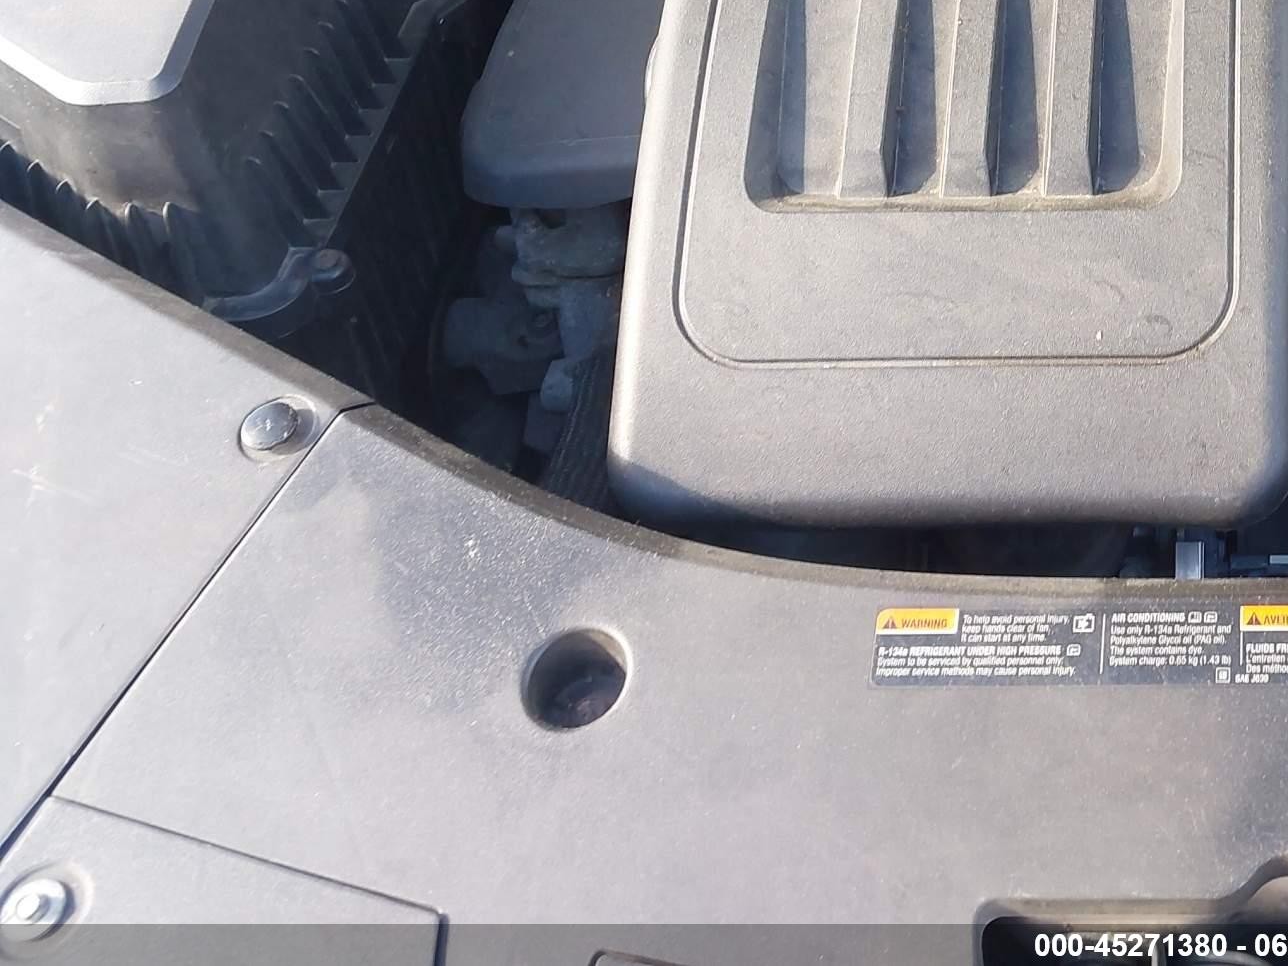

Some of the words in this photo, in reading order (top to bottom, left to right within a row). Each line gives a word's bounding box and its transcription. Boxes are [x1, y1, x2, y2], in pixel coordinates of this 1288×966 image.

[963, 614, 972, 624] To
[973, 614, 990, 624] help
[991, 614, 1012, 624] avoid
[1013, 614, 1045, 624] personal
[1111, 612, 1126, 623] AIR
[1127, 612, 1185, 623] CONDITIONING
[901, 618, 948, 629] WARNING
[962, 624, 980, 634] keep
[982, 624, 1005, 634] hands
[1007, 624, 1026, 634] clear
[1027, 624, 1036, 634] of
[1111, 625, 1126, 635] Use
[1126, 625, 1143, 635] only
[1144, 625, 1172, 635] R-134a
[1174, 625, 1216, 635] Refrigerant
[1217, 625, 1232, 635] and
[967, 634, 982, 643] can
[983, 634, 1001, 643] start
[1003, 634, 1011, 643] at
[1012, 634, 1026, 643] any
[1110, 635, 1157, 645] Polyalkylene
[1158, 635, 1181, 645] Glycol
[1182, 635, 1192, 645] oil
[1194, 635, 1212, 645] (PAG
[878, 645, 909, 656] R-134a
[909, 645, 966, 656] REFRIGERANT
[967, 645, 995, 656] UNDER
[996, 645, 1017, 656] HIGH
[1018, 645, 1062, 656] PRESSURE
[1110, 646, 1124, 656] The
[1126, 646, 1152, 656] system
[1154, 646, 1186, 656] contains
[1188, 646, 1204, 656] dye.
[1246, 642, 1274, 653] FLUIDE
[877, 656, 906, 666] System
[907, 656, 915, 666] to
[916, 656, 927, 666] be
[928, 656, 960, 666] serviced
[962, 656, 972, 666] by
[973, 656, 1005, 666] qualified
[1006, 656, 1044, 666] personnel
[1109, 656, 1137, 666] System
[1138, 656, 1168, 666] charge:
[1188, 656, 1198, 666] kg
[1221, 656, 1231, 666] lb)
[876, 667, 912, 677] Improper
[912, 667, 940, 677] service
[941, 667, 975, 677] methods
[976, 667, 993, 677] may
[994, 667, 1017, 677] cause
[1018, 667, 1051, 677] personal
[1246, 664, 1261, 673] Des
